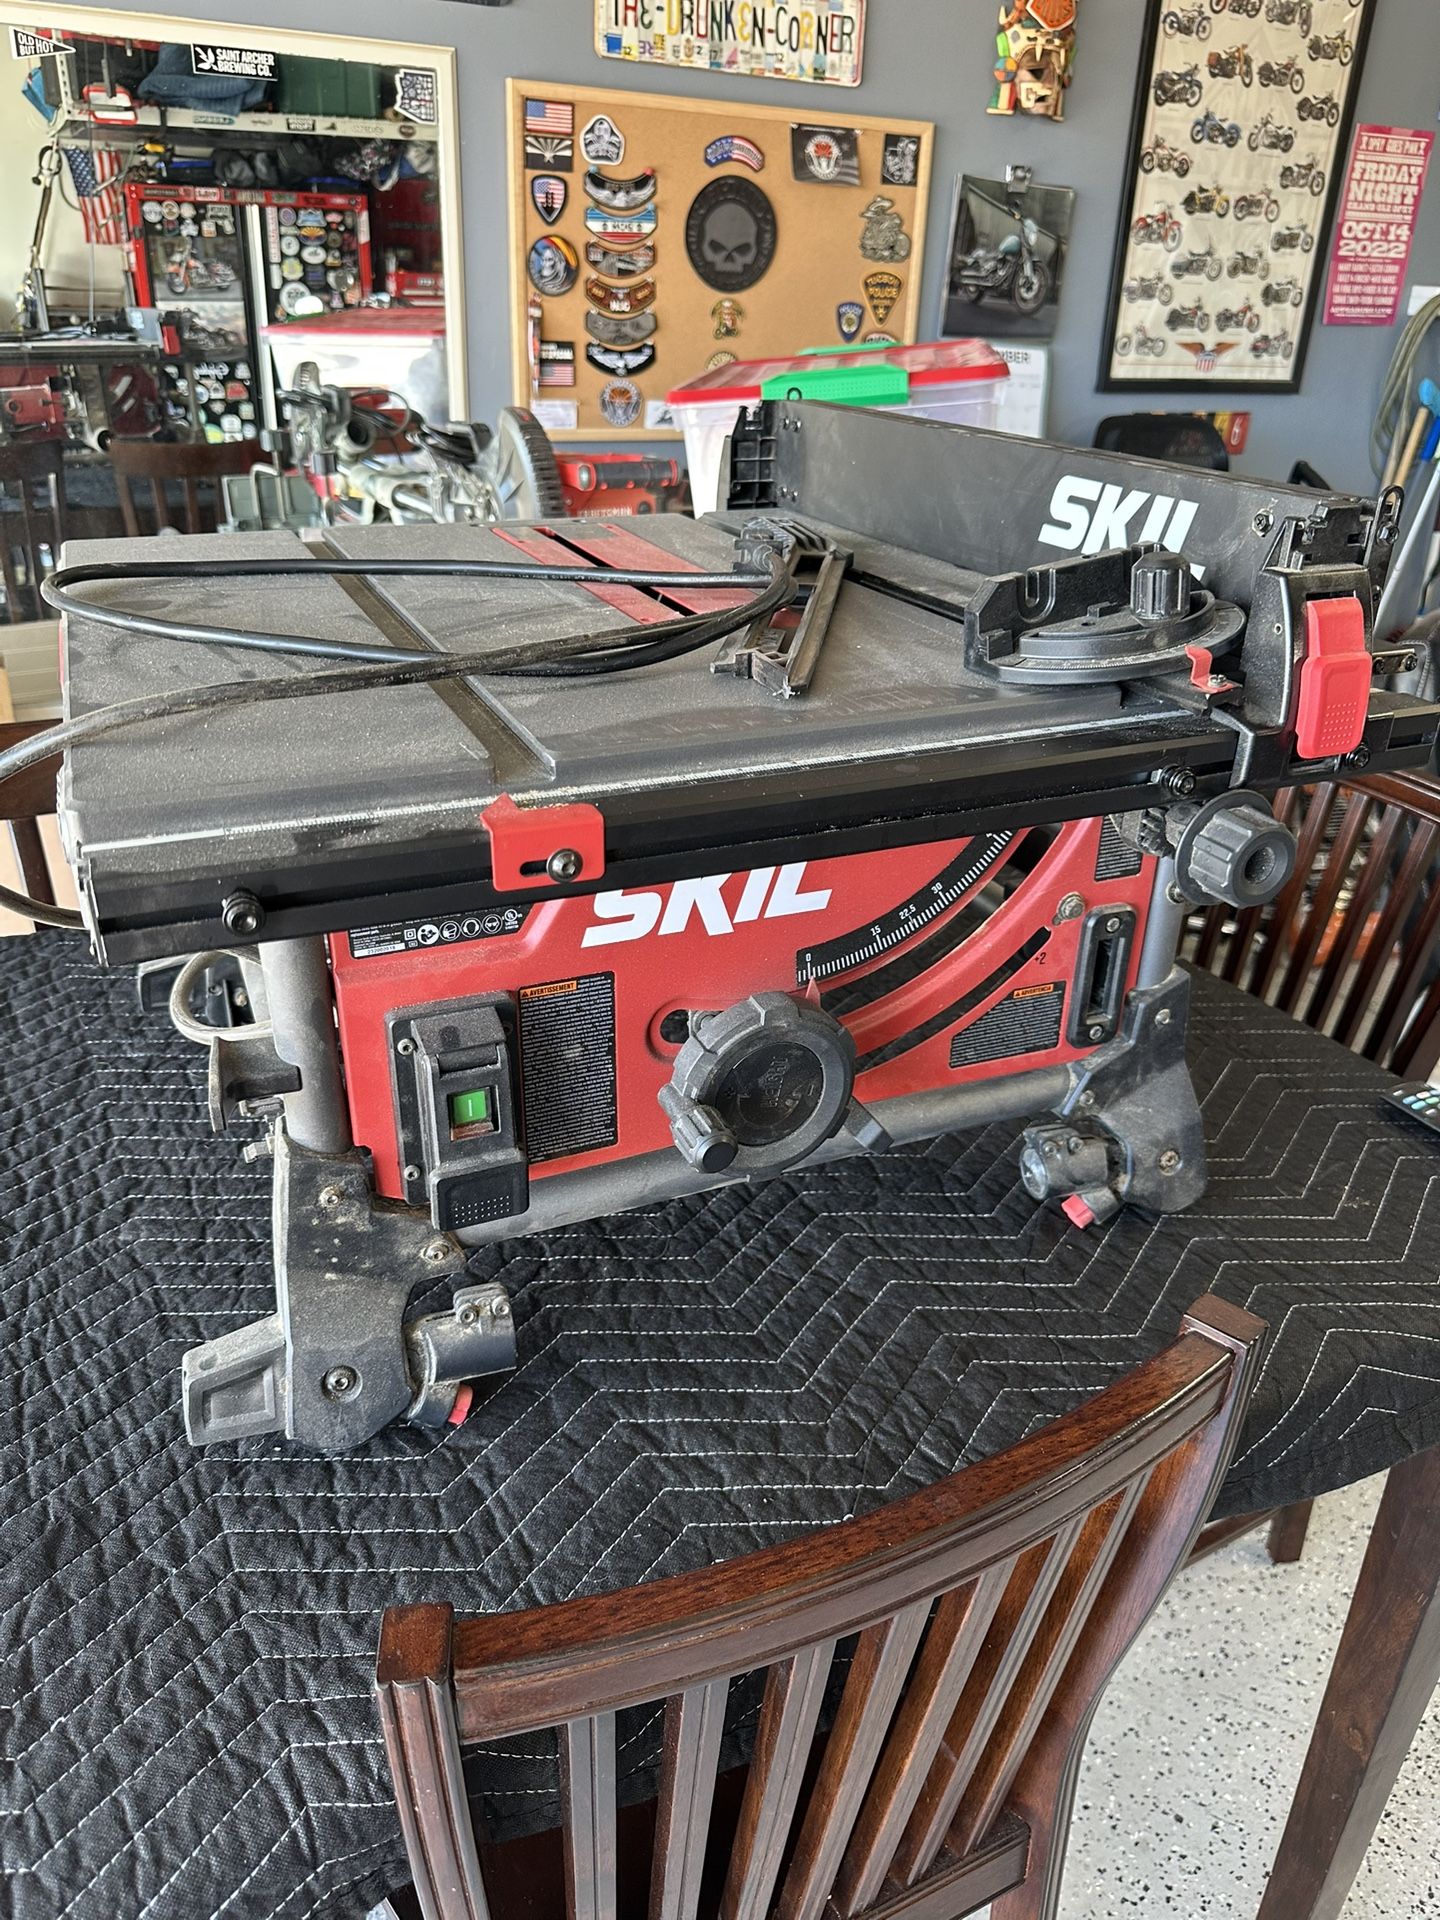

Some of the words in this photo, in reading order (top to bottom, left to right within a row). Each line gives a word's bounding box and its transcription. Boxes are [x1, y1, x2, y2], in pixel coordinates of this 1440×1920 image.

[17, 32, 35, 46] OLD
[20, 44, 35, 56] BUT
[35, 37, 54, 54] HOT
[216, 48, 240, 61] SAINT
[241, 51, 275, 66] ARCHER
[217, 60, 257, 75] BREWING
[257, 64, 272, 77] CO.
[1351, 161, 1424, 185] FRIDAY
[1347, 180, 1419, 205] NIGHT
[1341, 221, 1386, 240] OCT.
[1387, 223, 1411, 241] 14
[1337, 239, 1407, 258] 2022
[869, 287, 899, 298] POLICE
[1038, 475, 1206, 581] SKIL
[931, 882, 943, 895] 30
[580, 861, 832, 949] SKIL
[898, 904, 917, 919] 22.5
[869, 925, 882, 937] 15
[805, 952, 812, 962] 0
[1034, 952, 1047, 965] +2
[529, 982, 575, 997] AVERTISSEMENT
[1020, 985, 1053, 996] ADVERTENCIA
